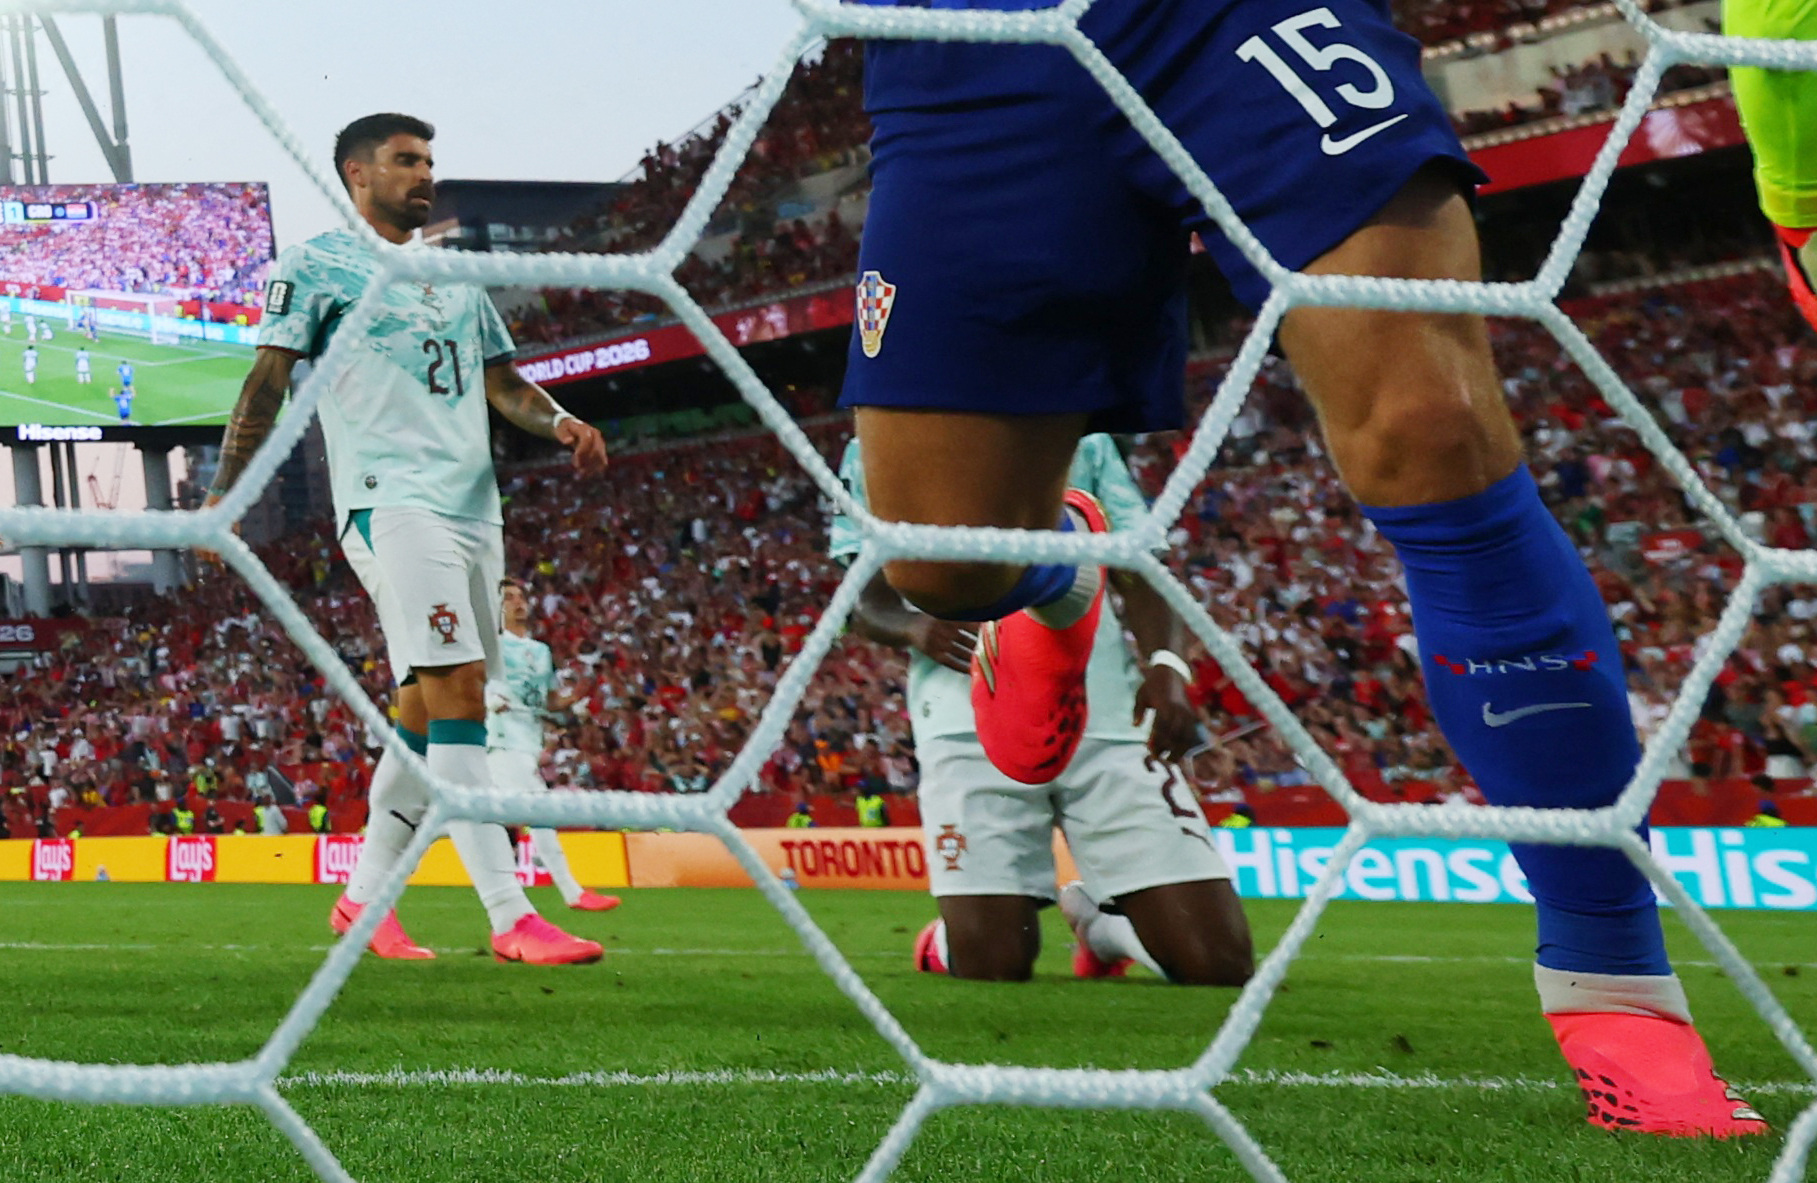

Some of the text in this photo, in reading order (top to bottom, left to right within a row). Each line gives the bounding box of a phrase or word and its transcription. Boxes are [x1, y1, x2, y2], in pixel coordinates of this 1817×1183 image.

[1235, 7, 1394, 129] 15
[423, 339, 464, 397] 21
[563, 350, 595, 376] CUP
[593, 338, 651, 369] 2026
[17, 423, 103, 441] Hisense
[1466, 654, 1568, 675] HNS
[34, 838, 71, 881] Lay's
[170, 836, 212, 882] Lay's
[780, 840, 927, 879] TORONTO
[1649, 828, 1817, 907] His
